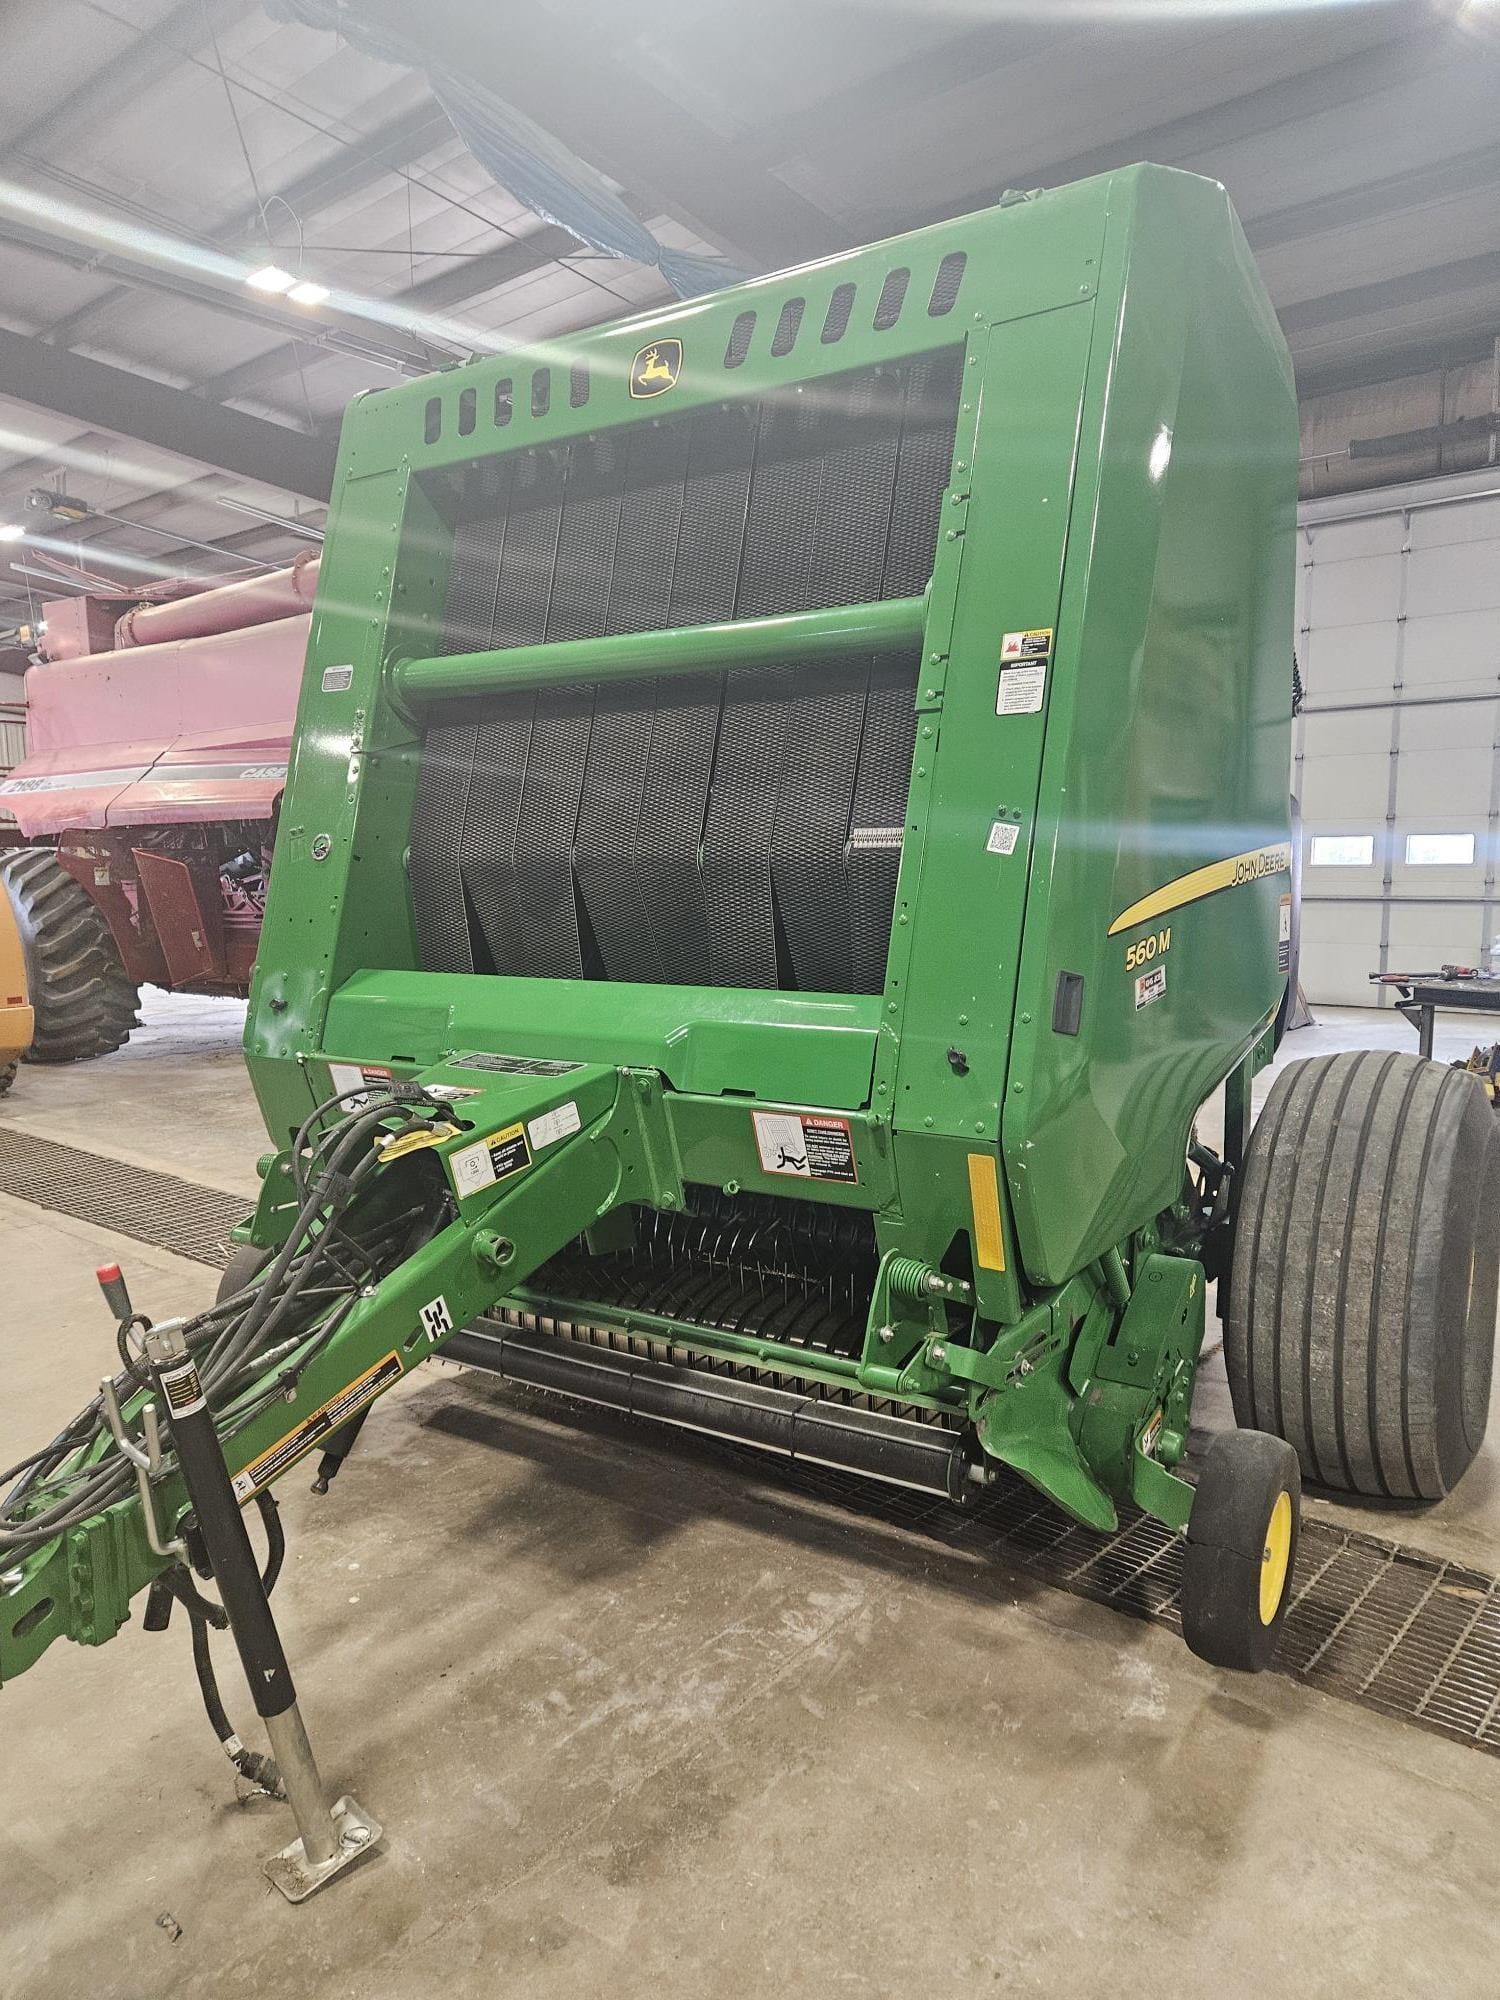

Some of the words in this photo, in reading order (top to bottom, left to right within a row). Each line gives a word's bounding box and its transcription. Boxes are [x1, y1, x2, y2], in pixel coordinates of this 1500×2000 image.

[1232, 859, 1258, 885] JOHN
[1258, 851, 1285, 875] DEERE
[1126, 943, 1158, 972] 560
[1158, 926, 1171, 955] M
[496, 1128, 520, 1143] CAUTION
[813, 1119, 844, 1129] DANGER
